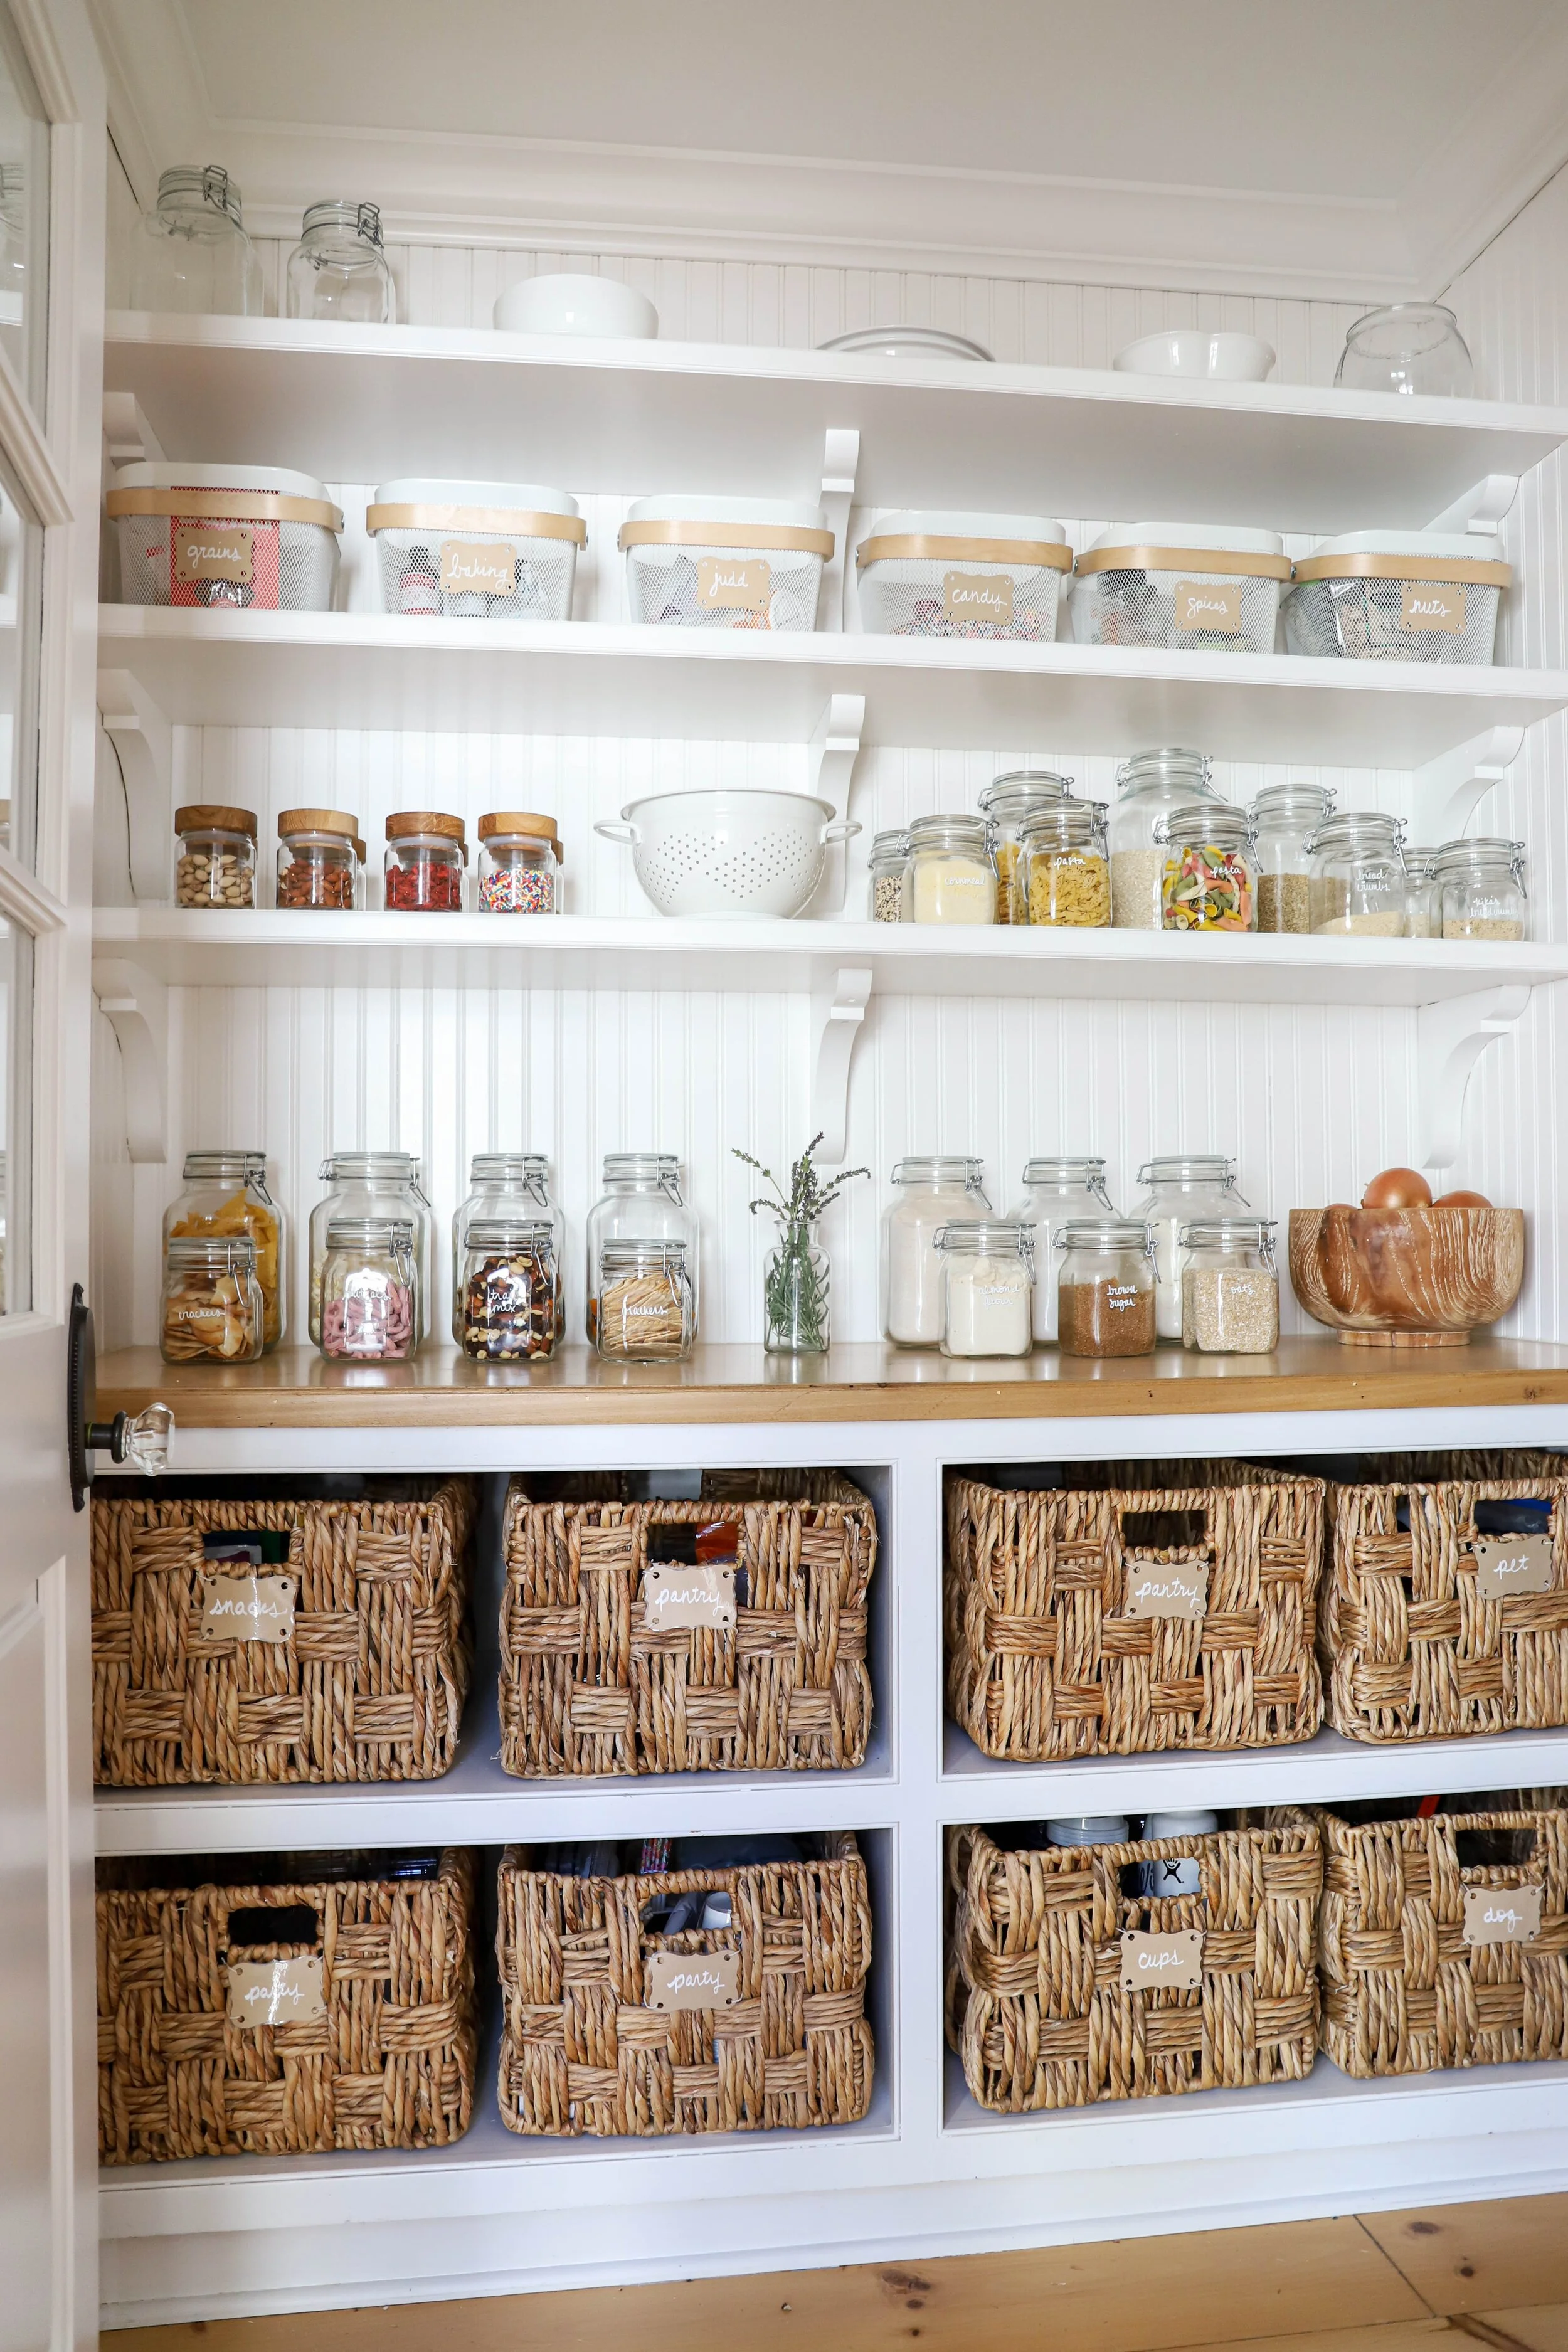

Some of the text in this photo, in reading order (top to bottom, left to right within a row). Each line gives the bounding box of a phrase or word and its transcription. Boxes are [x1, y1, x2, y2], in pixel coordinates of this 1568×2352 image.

[187, 541, 243, 569] grains
[447, 553, 511, 590] baking
[709, 564, 748, 596] judd
[952, 588, 1007, 612] candy
[1187, 595, 1229, 620] spices
[1409, 599, 1452, 617] nuts
[1054, 857, 1086, 871] pasta
[1210, 866, 1242, 879] pasta
[1356, 869, 1385, 880] bread
[978, 1283, 1020, 1295] almond
[1106, 1284, 1138, 1296] brown
[1231, 1283, 1256, 1295] oats
[178, 1308, 226, 1320] crackers
[491, 1304, 516, 1313] mix
[1108, 1298, 1136, 1312] sugar
[1493, 1554, 1530, 1580] pet
[654, 1586, 724, 1617] pantry
[1135, 1577, 1201, 1608] pantry
[209, 1598, 288, 1618] snacks
[1483, 1906, 1523, 1933] dog
[1138, 1949, 1184, 1971] cups
[667, 1970, 726, 1994] party
